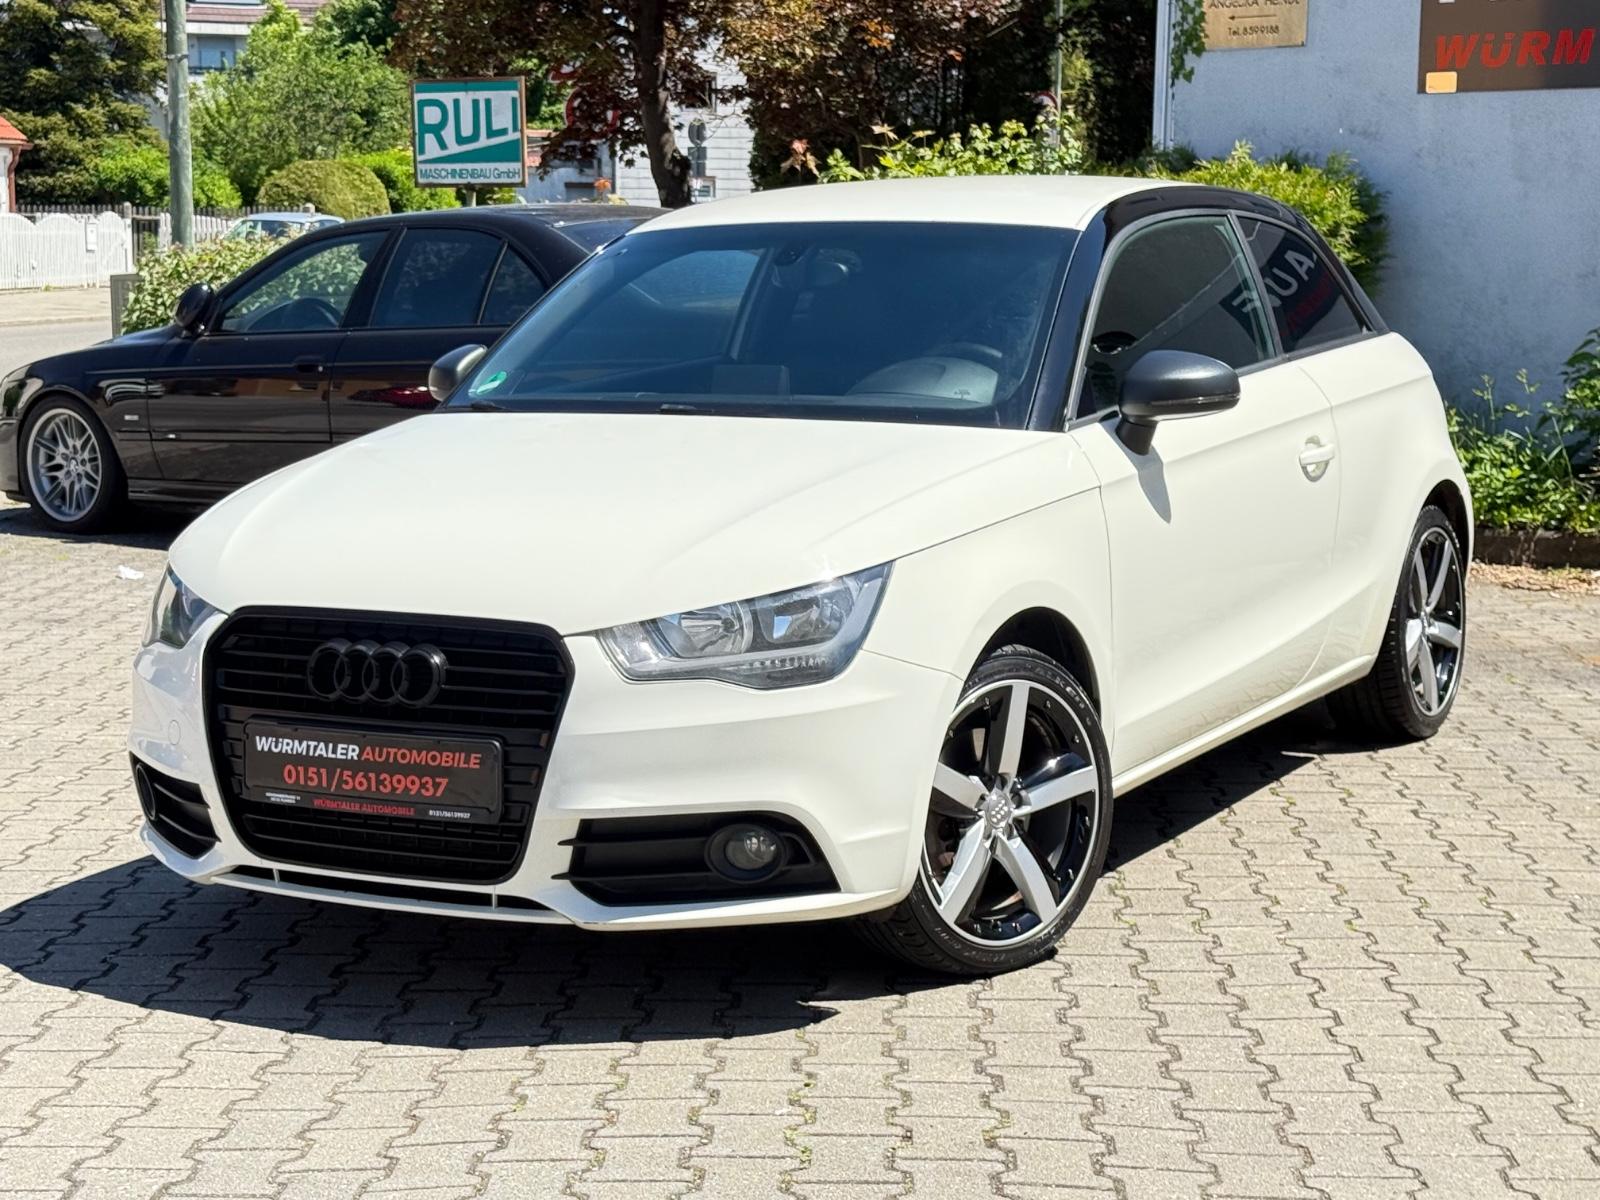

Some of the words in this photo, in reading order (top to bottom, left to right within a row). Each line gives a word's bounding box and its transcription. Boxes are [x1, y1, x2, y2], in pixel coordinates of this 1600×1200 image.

[1435, 27, 1600, 69] WÜRM
[417, 96, 519, 156] RULI
[420, 167, 491, 180] MASCHINENBAU
[493, 167, 520, 179] GmbH
[255, 735, 360, 761] WÜRMTALER
[361, 746, 482, 769] AUTOMOBILE
[283, 764, 448, 797] 0151/56139937
[361, 803, 416, 816] AUTOMOBILE
